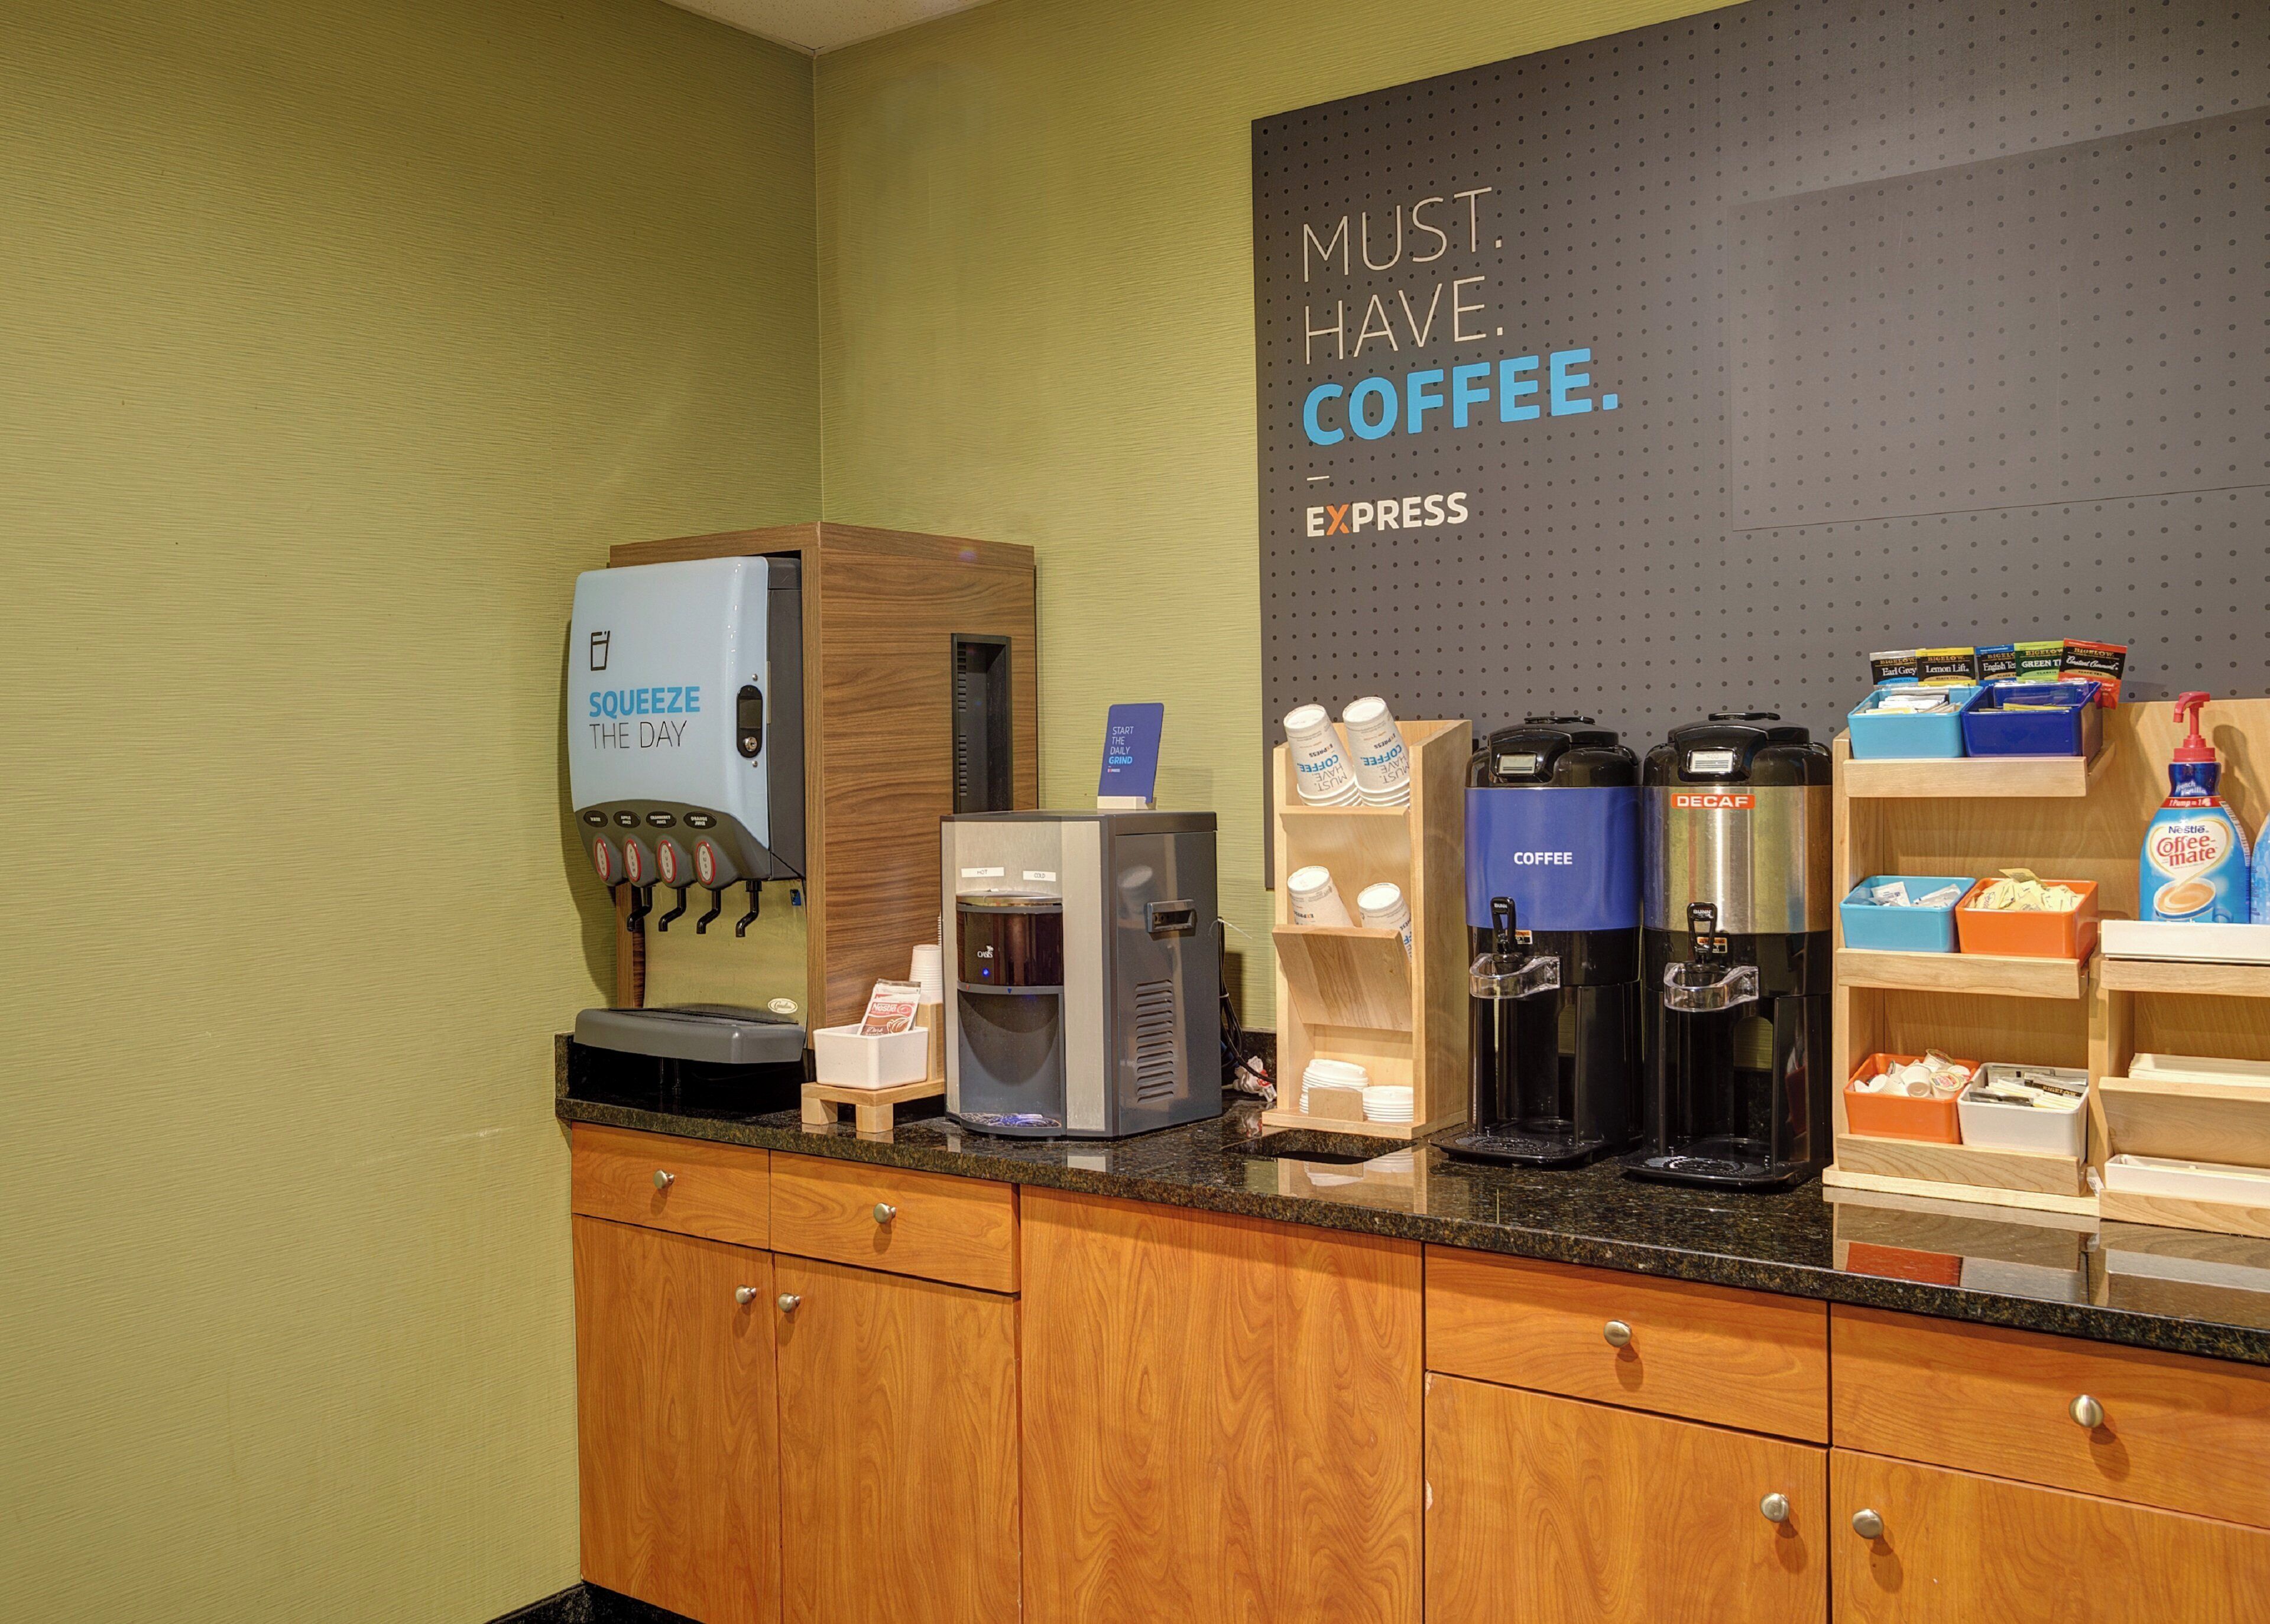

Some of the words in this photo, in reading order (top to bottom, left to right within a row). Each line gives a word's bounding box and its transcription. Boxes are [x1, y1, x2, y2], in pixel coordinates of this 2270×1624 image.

[1303, 187, 1502, 282] MUST.
[1305, 275, 1503, 365] HAVE.
[1303, 348, 1619, 446] COFFEE.
[1306, 492, 1468, 537] EXPRESS
[1882, 666, 1898, 676] Earl
[1983, 661, 2006, 673] English
[589, 686, 700, 719] SQUEEZE
[589, 722, 630, 749] THE
[640, 720, 687, 748] DAY
[1113, 726, 1134, 735] START
[1111, 736, 1125, 745] THE
[1374, 733, 1396, 749] EXPRESS
[1110, 746, 1130, 755] DAILY
[1309, 743, 1333, 758] EXPRESS
[1360, 744, 1402, 766] COFFEE.
[1297, 755, 1339, 773] COFFEE.
[1312, 762, 1344, 782] HAVE.
[1377, 753, 1408, 774] HAVE.
[1379, 762, 1409, 784] MUST.
[1314, 771, 1348, 791] MUST.
[1676, 795, 1749, 807] DECAF
[1513, 851, 1573, 865] COFFEE
[2169, 847, 2216, 866] mate
